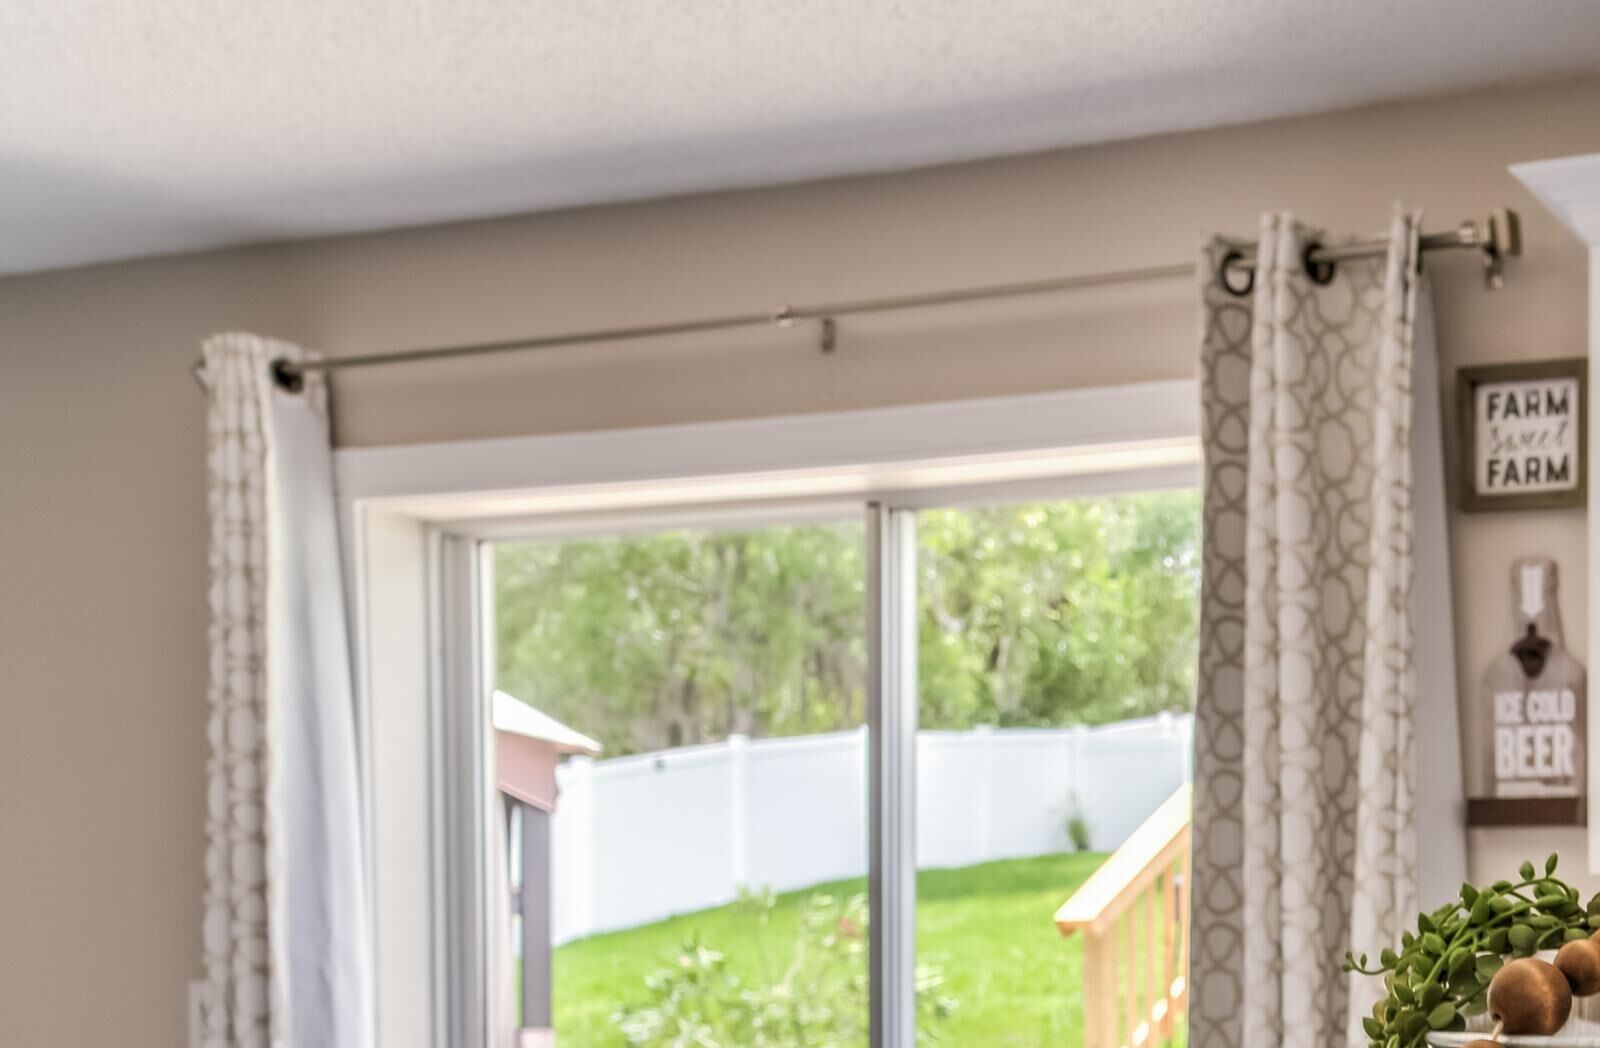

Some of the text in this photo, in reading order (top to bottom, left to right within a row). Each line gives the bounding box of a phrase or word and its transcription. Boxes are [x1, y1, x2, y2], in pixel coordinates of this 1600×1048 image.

[1487, 386, 1569, 423] FARM
[1487, 454, 1569, 488] FARM
[1494, 687, 1576, 724] ICE COLD
[1494, 723, 1576, 779] BEER
